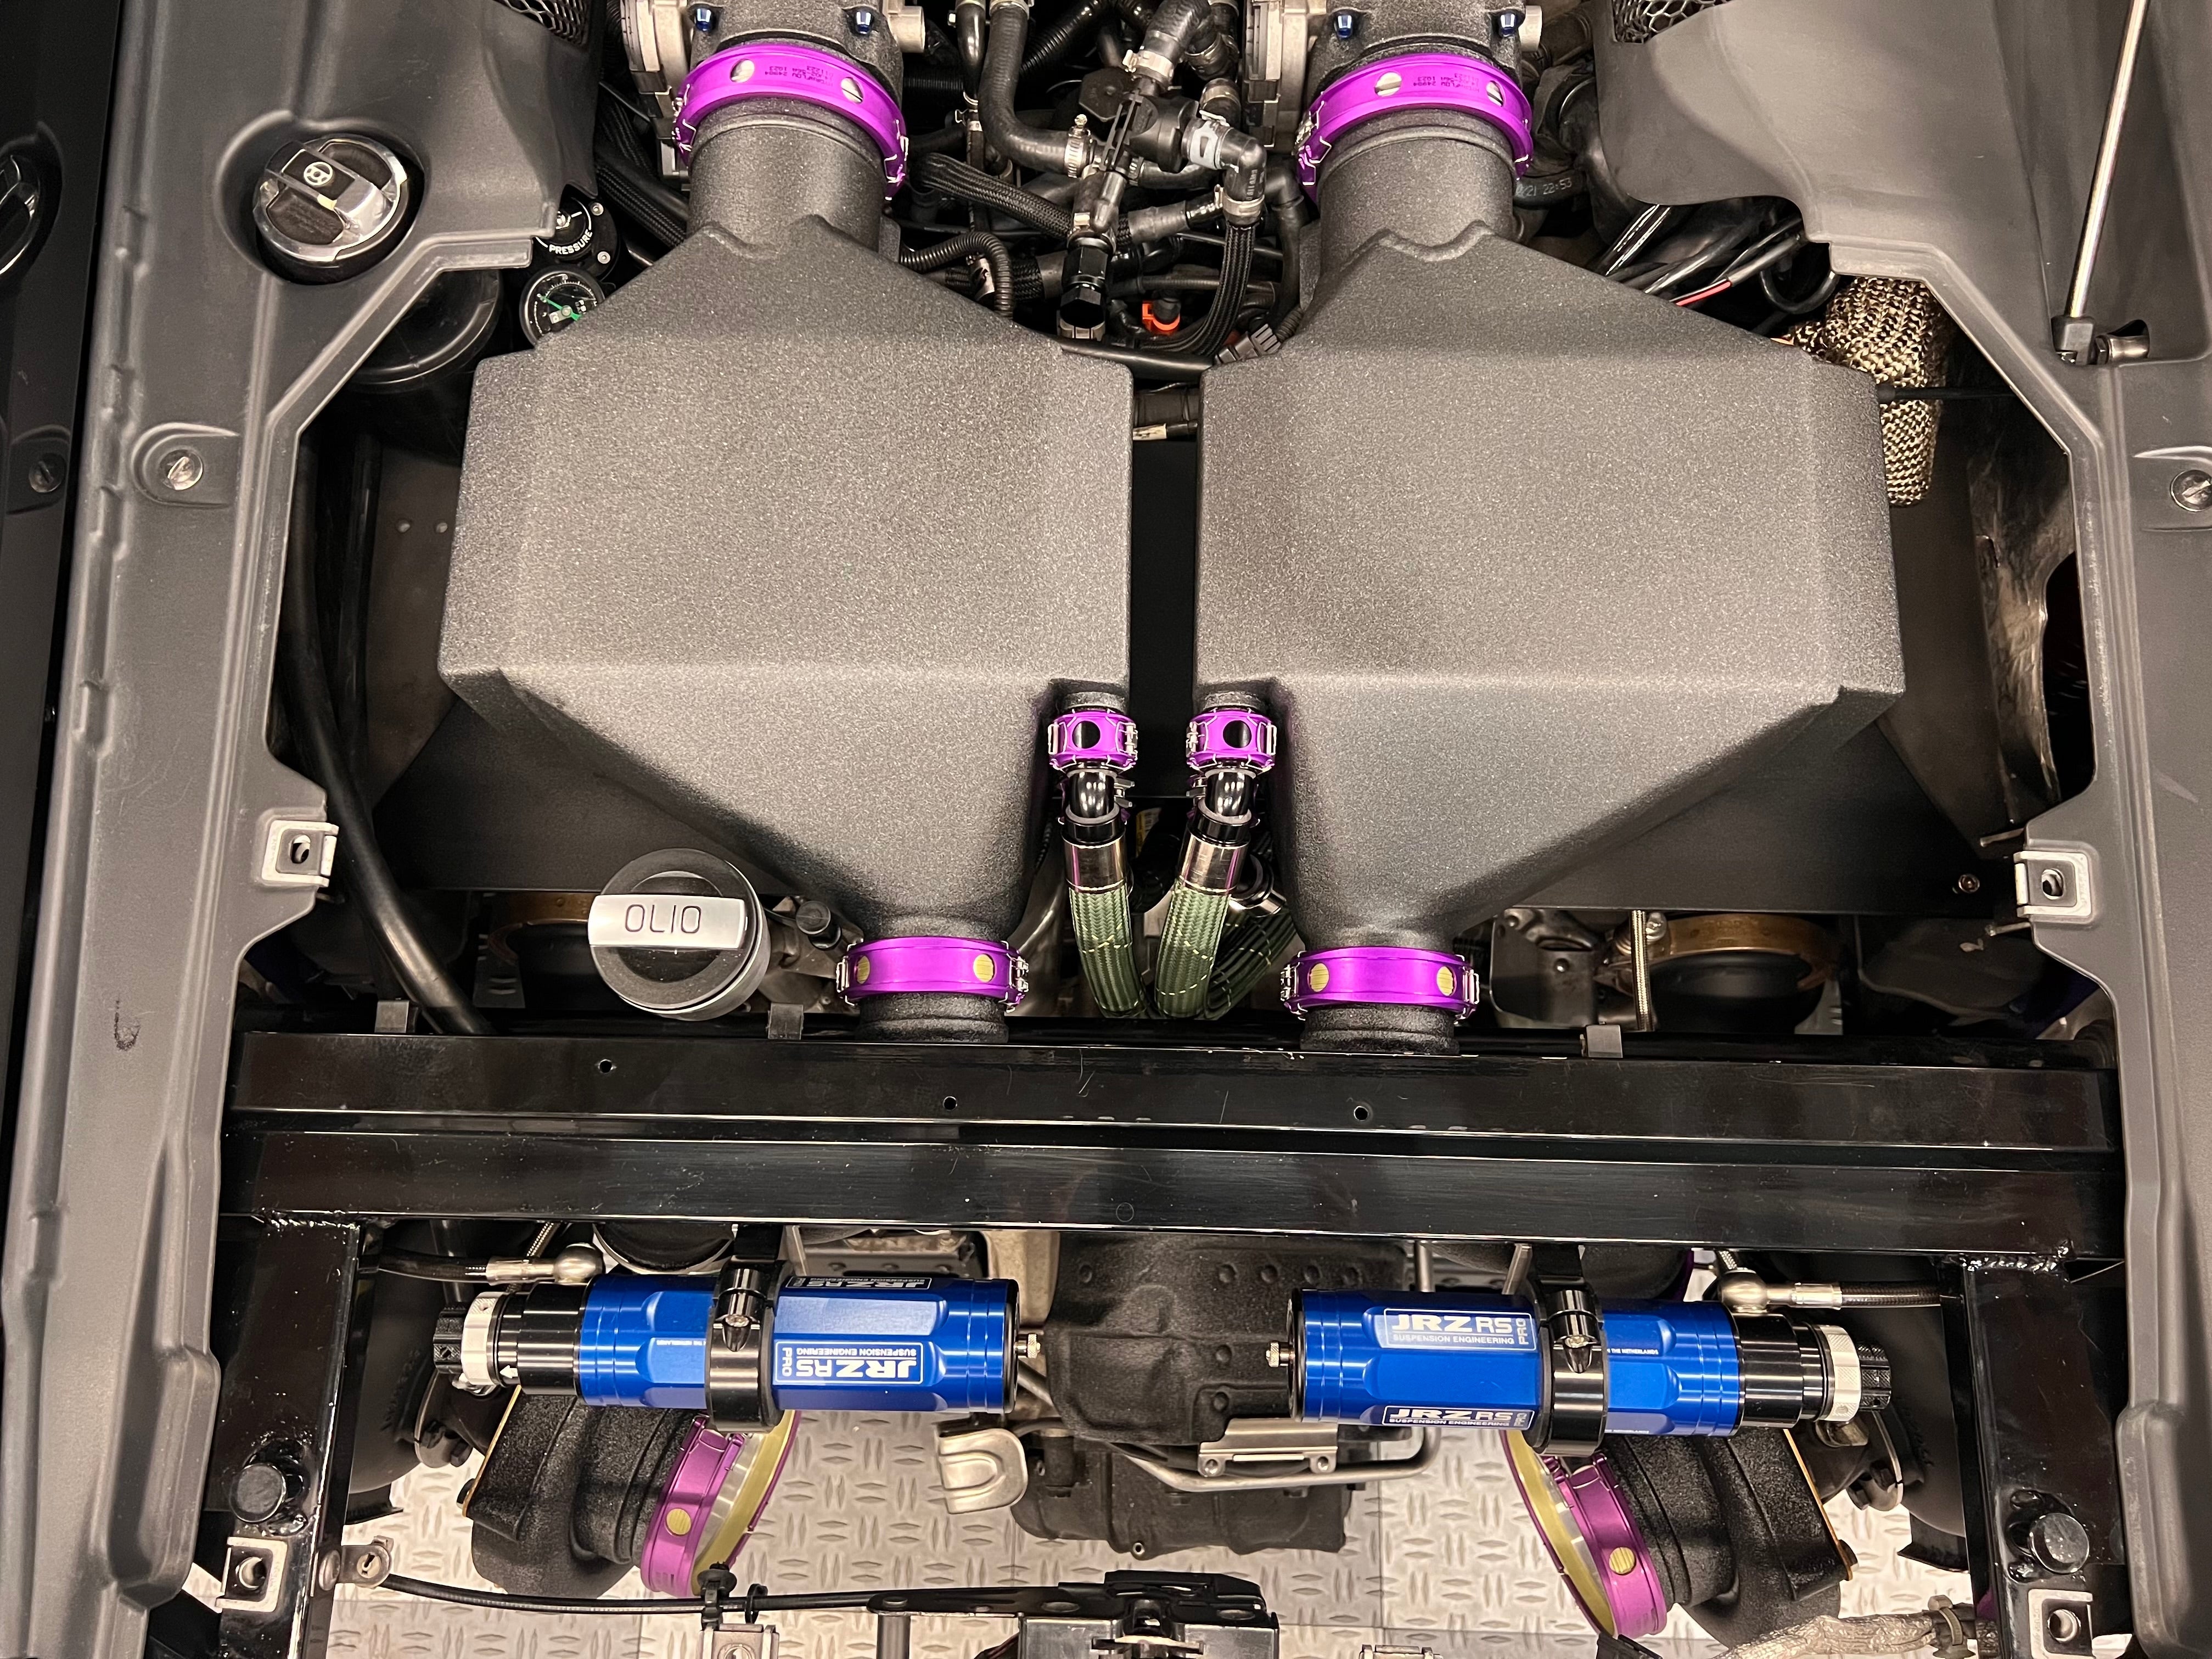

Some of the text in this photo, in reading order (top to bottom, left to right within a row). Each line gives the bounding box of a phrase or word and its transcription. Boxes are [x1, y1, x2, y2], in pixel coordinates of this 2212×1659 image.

[1542, 177, 1572, 194] 22:53
[549, 229, 593, 254] PRESSURE
[625, 904, 701, 933] OLIO
[1392, 1314, 1512, 1333] JRZ RS
[1515, 1318, 1529, 1345] PRO
[1393, 1334, 1514, 1344] SUSPENSION ENGINEERING
[796, 1347, 917, 1357] SUSPENSION ENGINEERING
[782, 1347, 793, 1377] PRO
[796, 1359, 917, 1378] JRZ RS
[1390, 1409, 1472, 1420] JRZ
